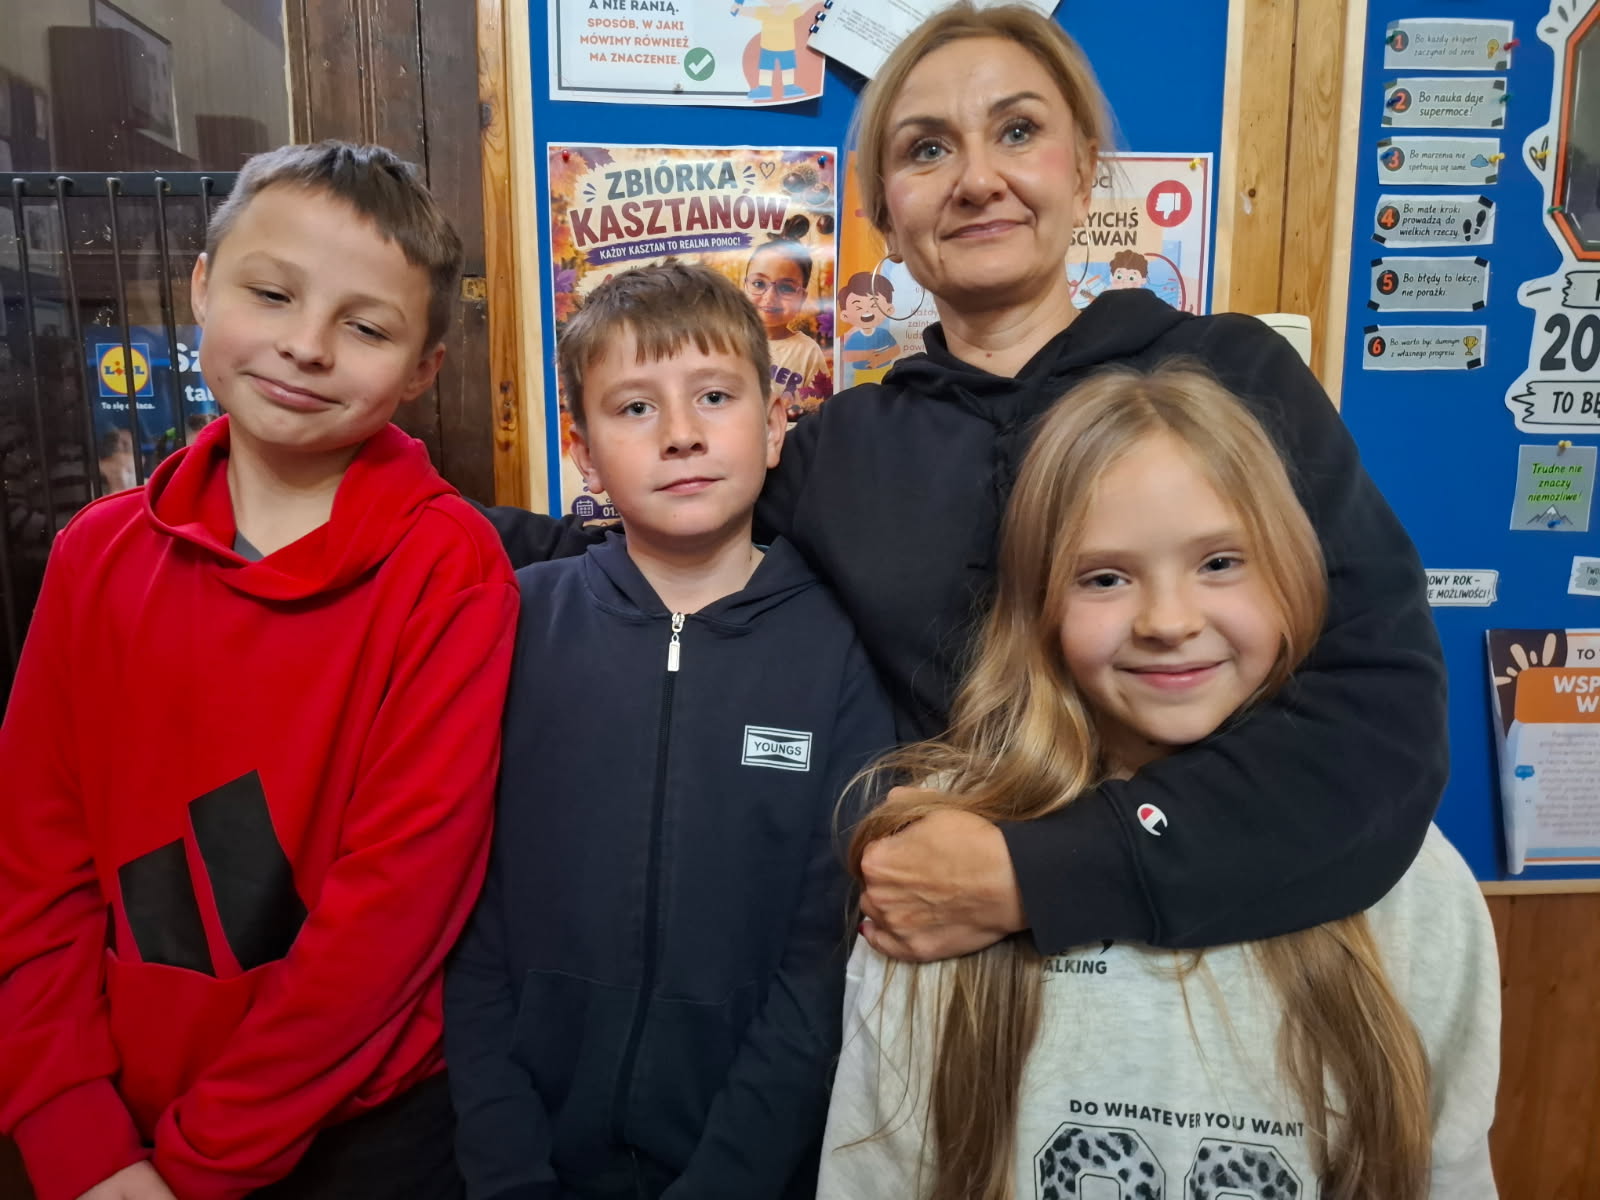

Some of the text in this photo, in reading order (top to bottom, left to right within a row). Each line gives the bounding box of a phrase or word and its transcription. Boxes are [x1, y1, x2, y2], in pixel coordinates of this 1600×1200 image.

[589, 0, 679, 15] A NIE RANIĄ.
[642, 20, 653, 29] W
[656, 20, 684, 31] JAKI
[580, 32, 689, 48] MÓWIMY RÓWNIEŻ
[589, 53, 680, 65] MA ZNACZENIE.
[1395, 92, 1407, 110] 2
[1418, 91, 1484, 106] Bo nauka daje
[1419, 106, 1473, 118] supermoce!
[1388, 150, 1400, 168] 3
[1409, 149, 1419, 159] Bo
[605, 160, 738, 200] ZBIÓRKA
[1403, 203, 1414, 214] Bo
[1440, 204, 1461, 214] kroki
[570, 189, 790, 247] KASZTANÓW
[1381, 208, 1394, 227] 4
[1402, 214, 1456, 226] prowadzą do
[1399, 227, 1430, 236] wielkich
[599, 236, 741, 260] KAŻDY KASZTAN TO REALNA POMOC!
[1382, 273, 1393, 291] 5
[1403, 272, 1414, 283] Bo
[1417, 272, 1441, 285] błędy
[1444, 273, 1453, 283] to
[1401, 289, 1413, 297] nie
[1372, 338, 1381, 354] 6
[1539, 313, 1600, 373] 20
[101, 401, 111, 410] To
[1553, 391, 1574, 414] TO
[1532, 463, 1583, 474] Trudne nie
[1538, 480, 1572, 490] znaczy
[1427, 575, 1450, 585] OWY
[1452, 575, 1474, 585] ROK
[1577, 649, 1595, 660] TO
[1553, 675, 1600, 693] WSP
[1576, 695, 1599, 713] W
[754, 741, 802, 756] YOUNGS
[1070, 1099, 1304, 1137] DO WHATEVER YOU WANT
